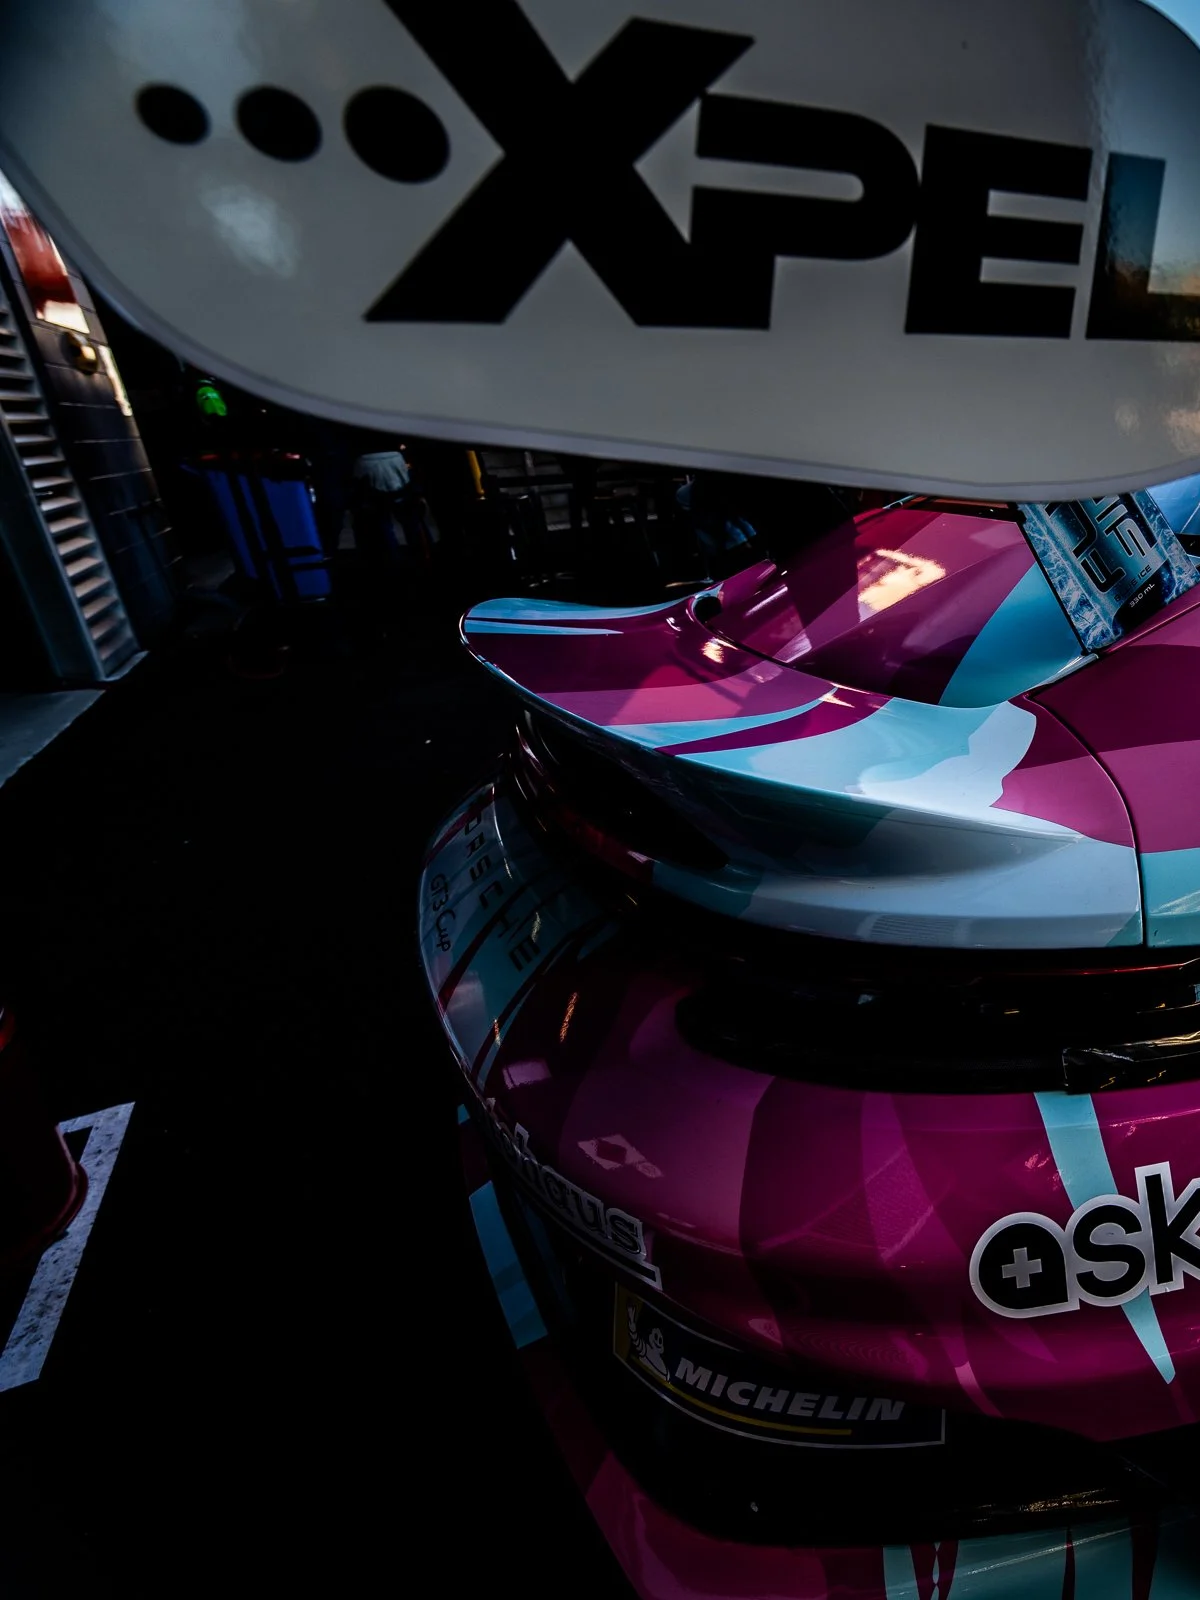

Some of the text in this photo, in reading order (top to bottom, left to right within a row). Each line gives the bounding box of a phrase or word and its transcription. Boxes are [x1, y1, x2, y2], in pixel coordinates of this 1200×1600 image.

[1137, 564, 1152, 582] ICE
[430, 873, 457, 953] GT3 Cup
[463, 806, 541, 973] ORSCHE
[674, 1356, 905, 1421] MICHELIN
